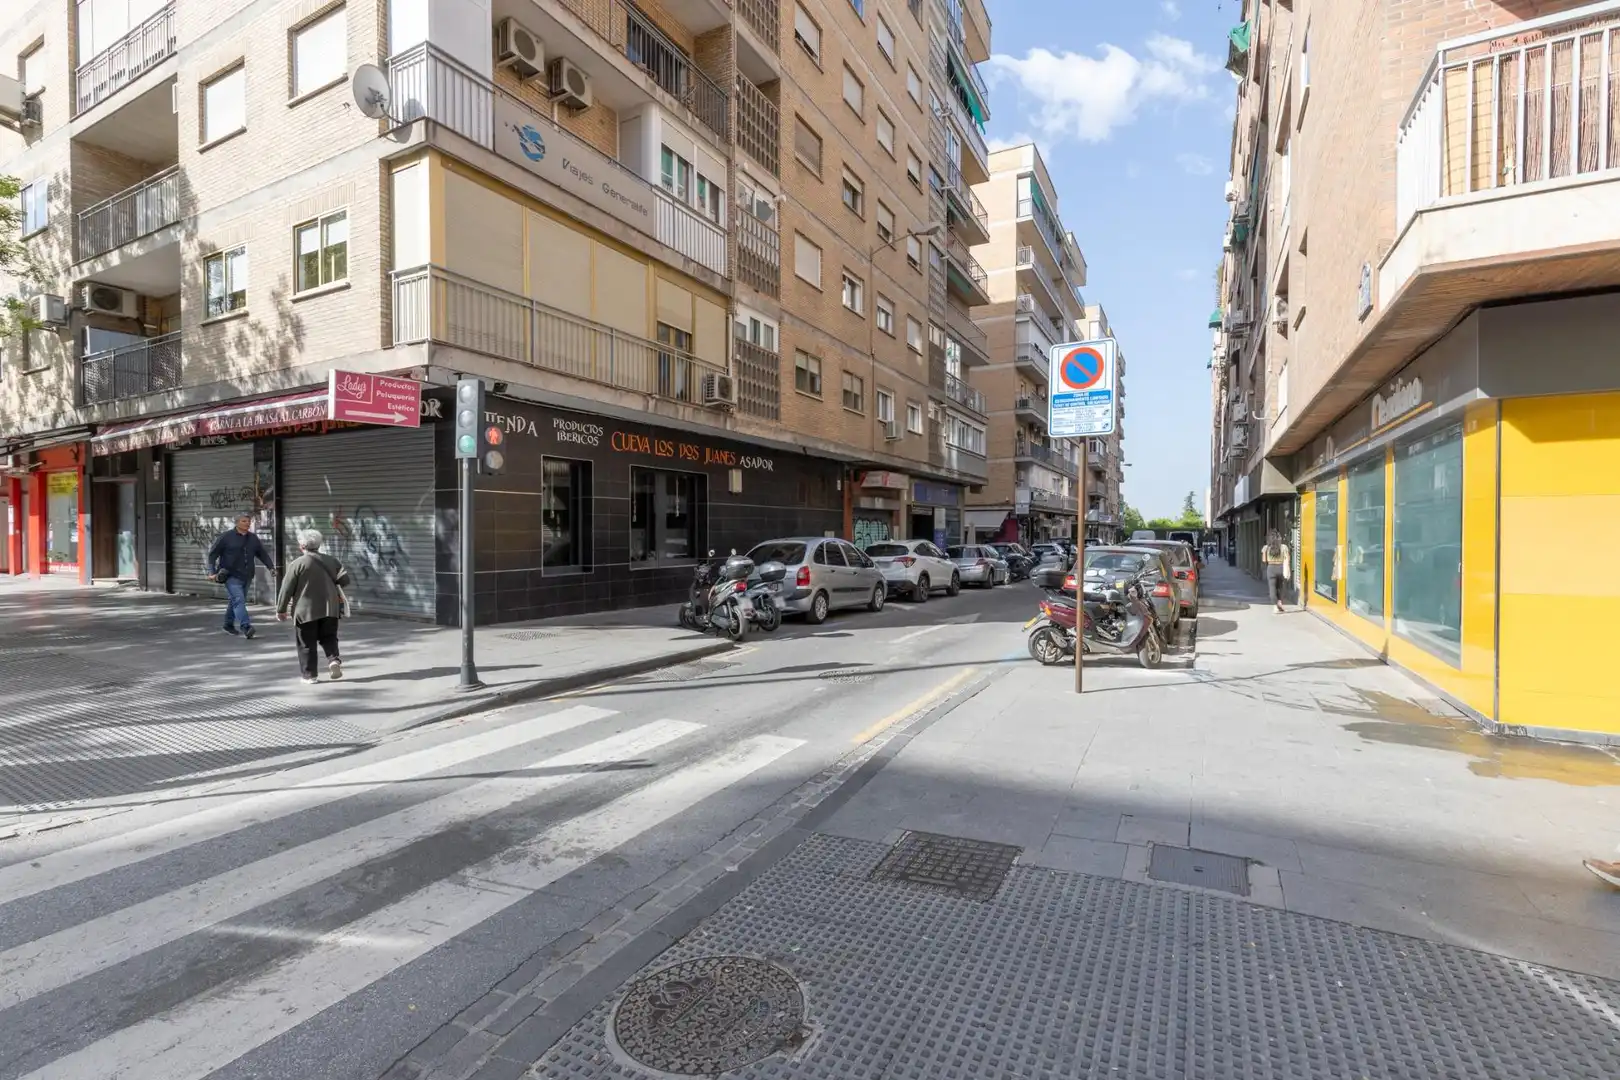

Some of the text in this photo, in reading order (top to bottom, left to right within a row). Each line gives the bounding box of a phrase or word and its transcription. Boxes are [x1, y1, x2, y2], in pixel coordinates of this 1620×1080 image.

[562, 157, 594, 185] Viajes
[380, 379, 416, 391] Productos
[484, 411, 538, 437] TIENDA
[552, 417, 604, 436] PRODUCTOS
[557, 430, 600, 447] IBERICOS
[611, 431, 737, 466] CUEVA LOS DOS JUANES
[739, 455, 774, 472] ASADOR
